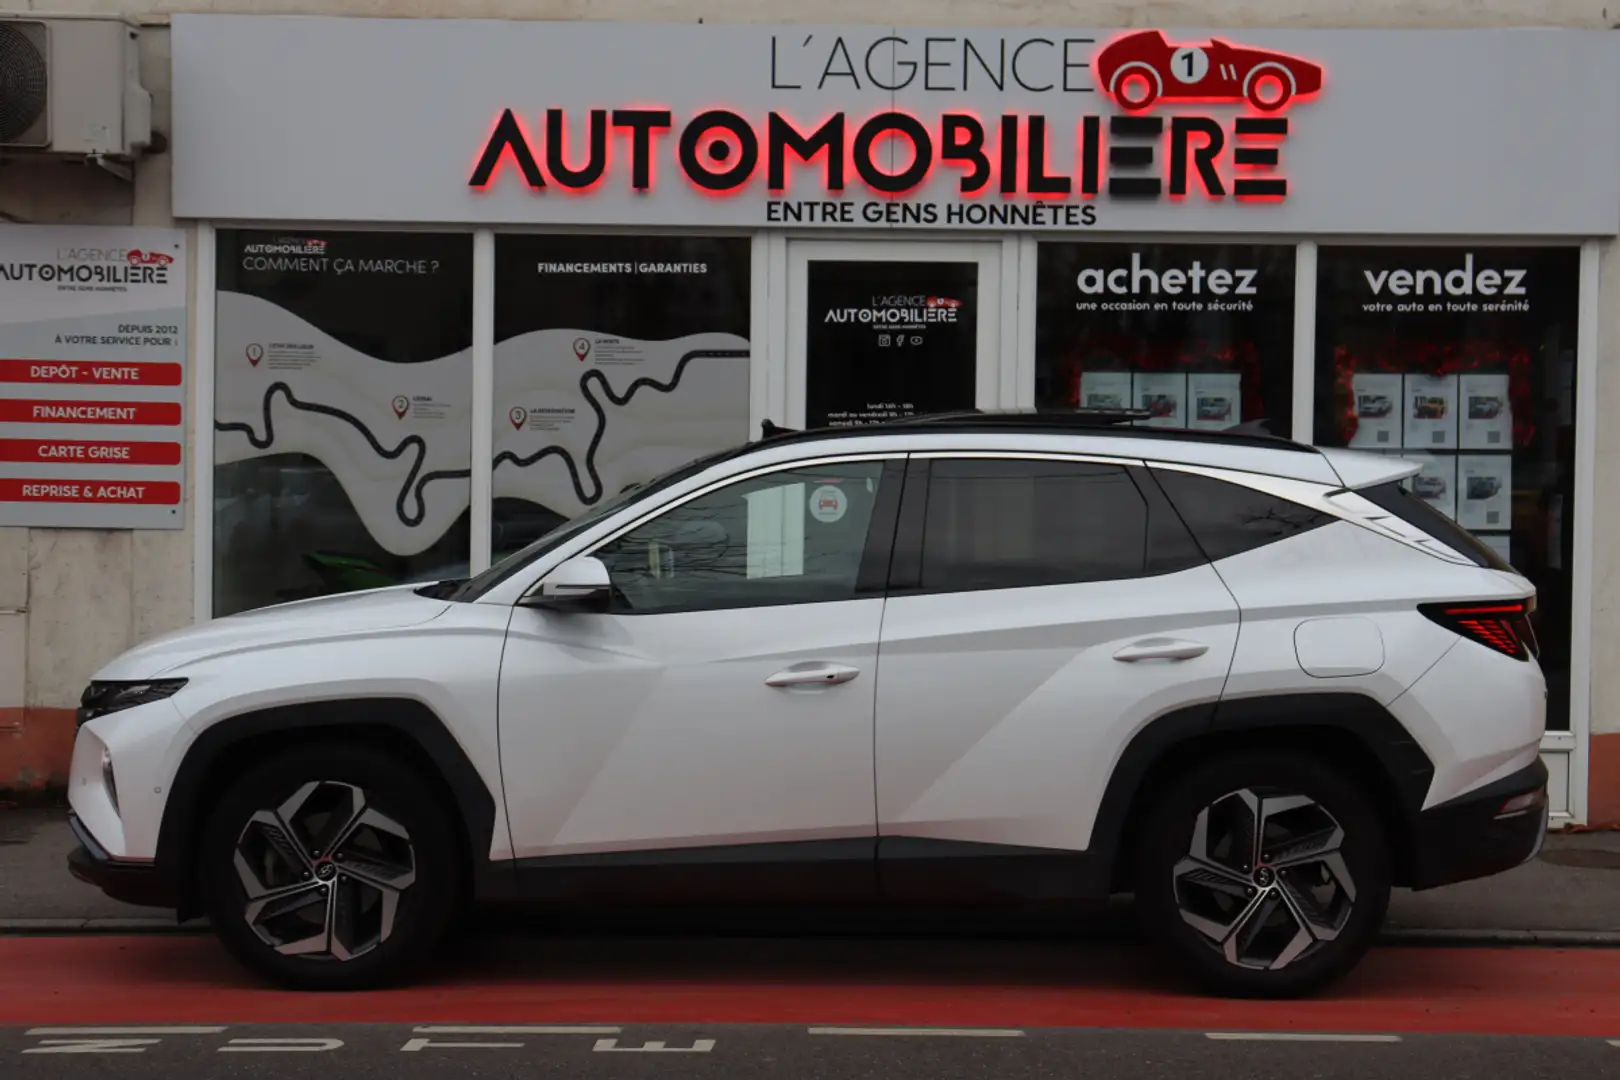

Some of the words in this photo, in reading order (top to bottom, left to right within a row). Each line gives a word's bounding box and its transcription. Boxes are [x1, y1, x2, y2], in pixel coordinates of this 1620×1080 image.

[770, 34, 1096, 92] L'AGENCE
[1180, 53, 1195, 77] 1
[766, 201, 854, 222] ENTRE
[862, 202, 938, 224] GENS
[946, 201, 1097, 226] HONNÊTES
[242, 256, 329, 272] COMMENT
[333, 258, 355, 275] ÇA
[358, 259, 427, 274] MARCHE
[430, 260, 439, 273] ?
[537, 262, 632, 273] FINANCEMENTS
[639, 262, 708, 273] GARANTIES
[1076, 252, 1258, 294] achetez
[1363, 253, 1527, 295] vendez
[872, 295, 926, 307] L'AGENCE
[1076, 302, 1098, 311] une
[1101, 299, 1150, 311] occasion
[1154, 302, 1168, 311] en
[1172, 300, 1203, 311] toute
[1207, 299, 1254, 311] sécurité
[1362, 302, 1393, 312] votre
[1397, 302, 1424, 312] auto
[1428, 304, 1442, 312] en
[1446, 302, 1478, 312] toute
[118, 324, 153, 334] DEPUIS
[156, 325, 178, 334] 2012
[65, 335, 97, 345] VOTRE
[100, 336, 141, 346] SERVICE
[143, 337, 171, 346] POUR
[30, 364, 78, 379] DEPÔT
[92, 367, 139, 380] VENTE
[32, 405, 136, 419] FINANCEMENT
[38, 445, 85, 458] CARTE
[88, 446, 130, 459] GRISE
[22, 484, 79, 497] REPRISE
[83, 485, 93, 498] &
[96, 486, 145, 499] ACHAT
